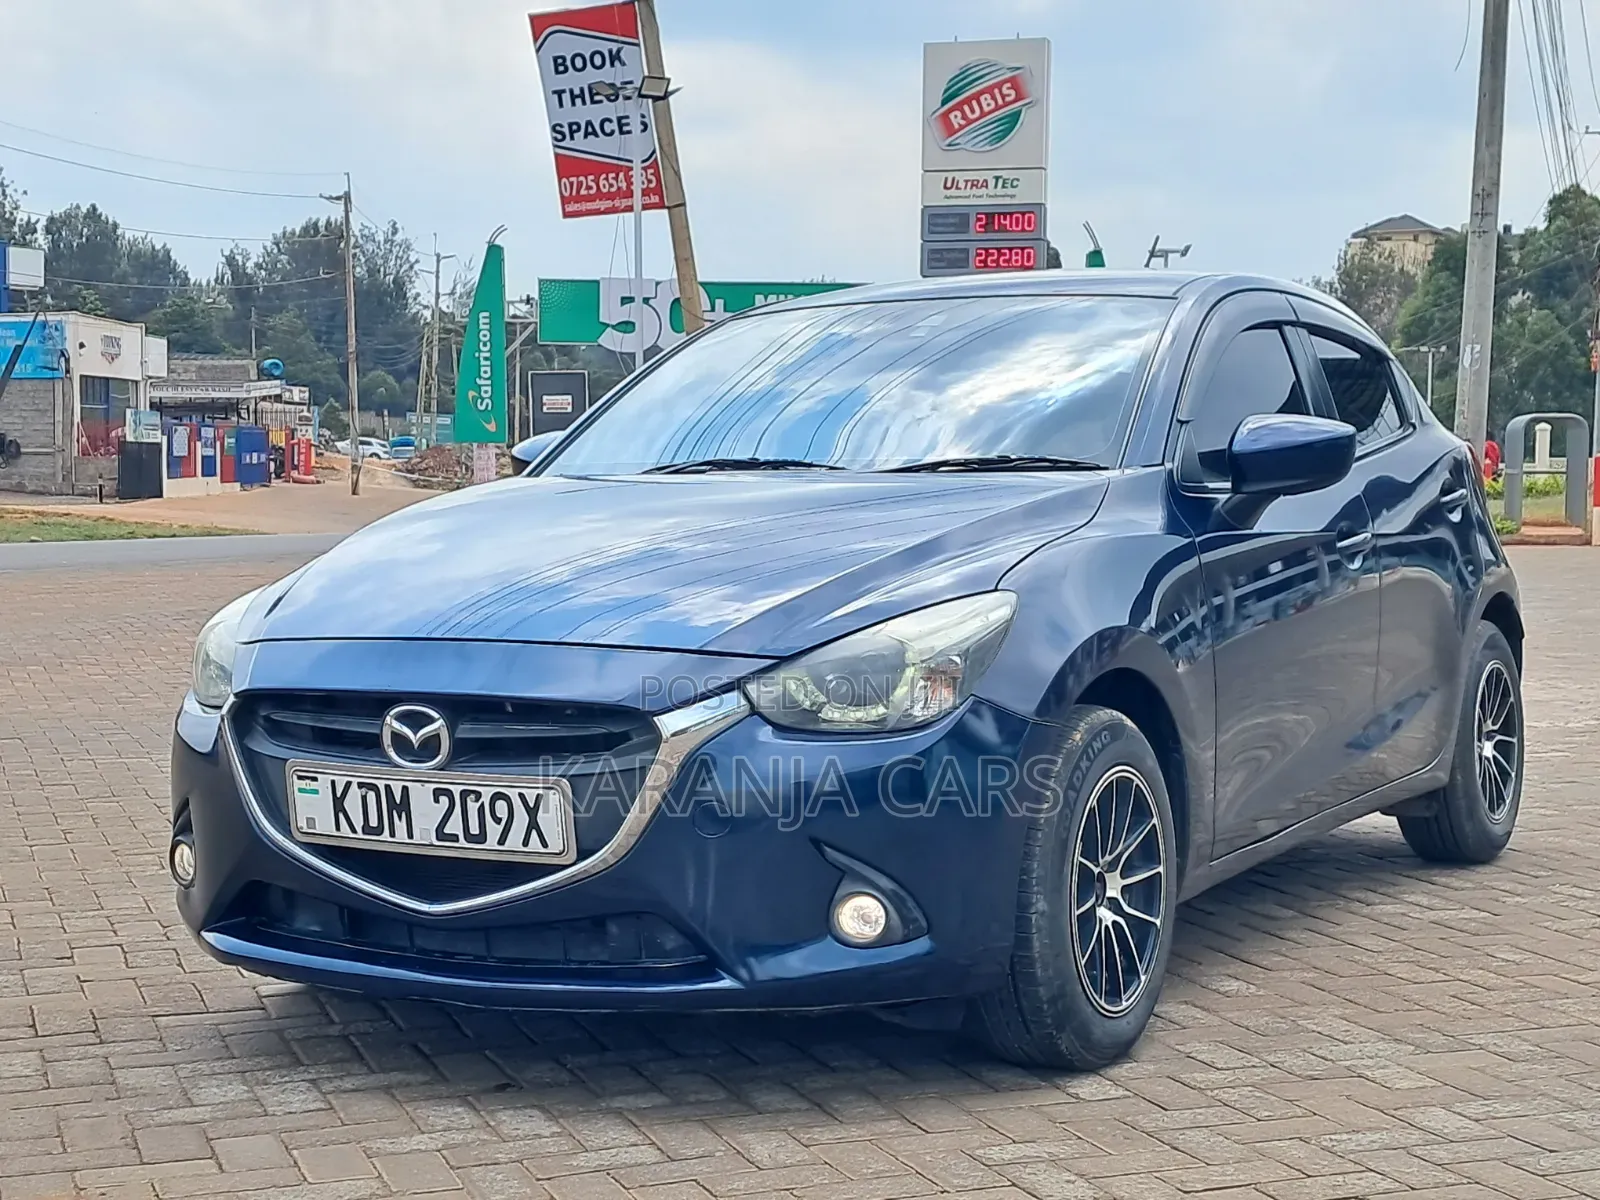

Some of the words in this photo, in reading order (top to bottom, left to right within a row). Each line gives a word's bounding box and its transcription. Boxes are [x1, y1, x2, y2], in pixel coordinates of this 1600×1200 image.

[552, 46, 627, 76] BOOK
[948, 82, 1016, 129] RUBIS
[551, 113, 649, 143] SPACES
[561, 175, 597, 197] 0725
[599, 172, 627, 193] 654
[943, 176, 989, 191] ULTRA
[992, 174, 1021, 190] TEC
[475, 311, 492, 411] Safaricom
[330, 778, 415, 841] KDM
[432, 787, 550, 849] 209X
